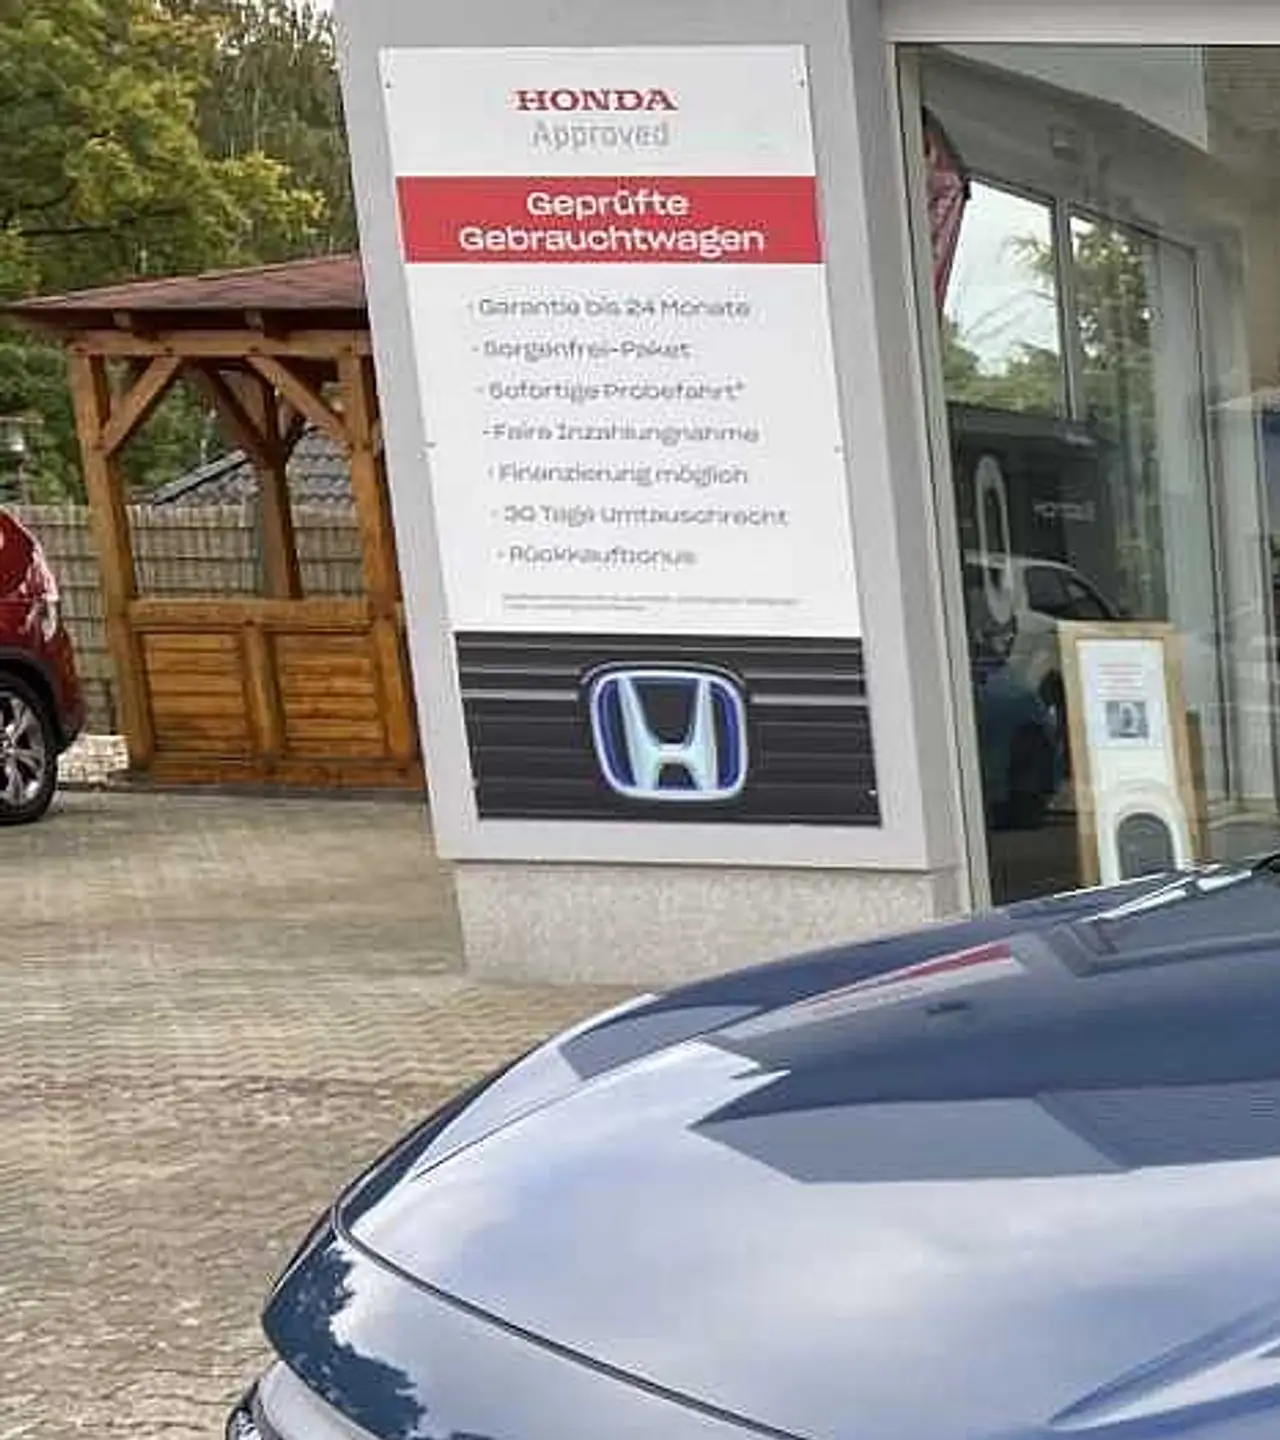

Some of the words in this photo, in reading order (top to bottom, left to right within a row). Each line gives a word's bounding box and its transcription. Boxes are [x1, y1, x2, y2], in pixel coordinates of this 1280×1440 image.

[515, 88, 679, 112] HONDA
[533, 120, 669, 151] Approved
[526, 189, 691, 220] Geprüfte
[458, 224, 765, 258] Gebrauchtwagen
[479, 298, 581, 316] Garantie
[585, 299, 622, 317] bis
[625, 299, 656, 316] 24
[660, 299, 751, 317] Monate
[498, 460, 652, 486] Finanzierung
[655, 462, 749, 488] möglich
